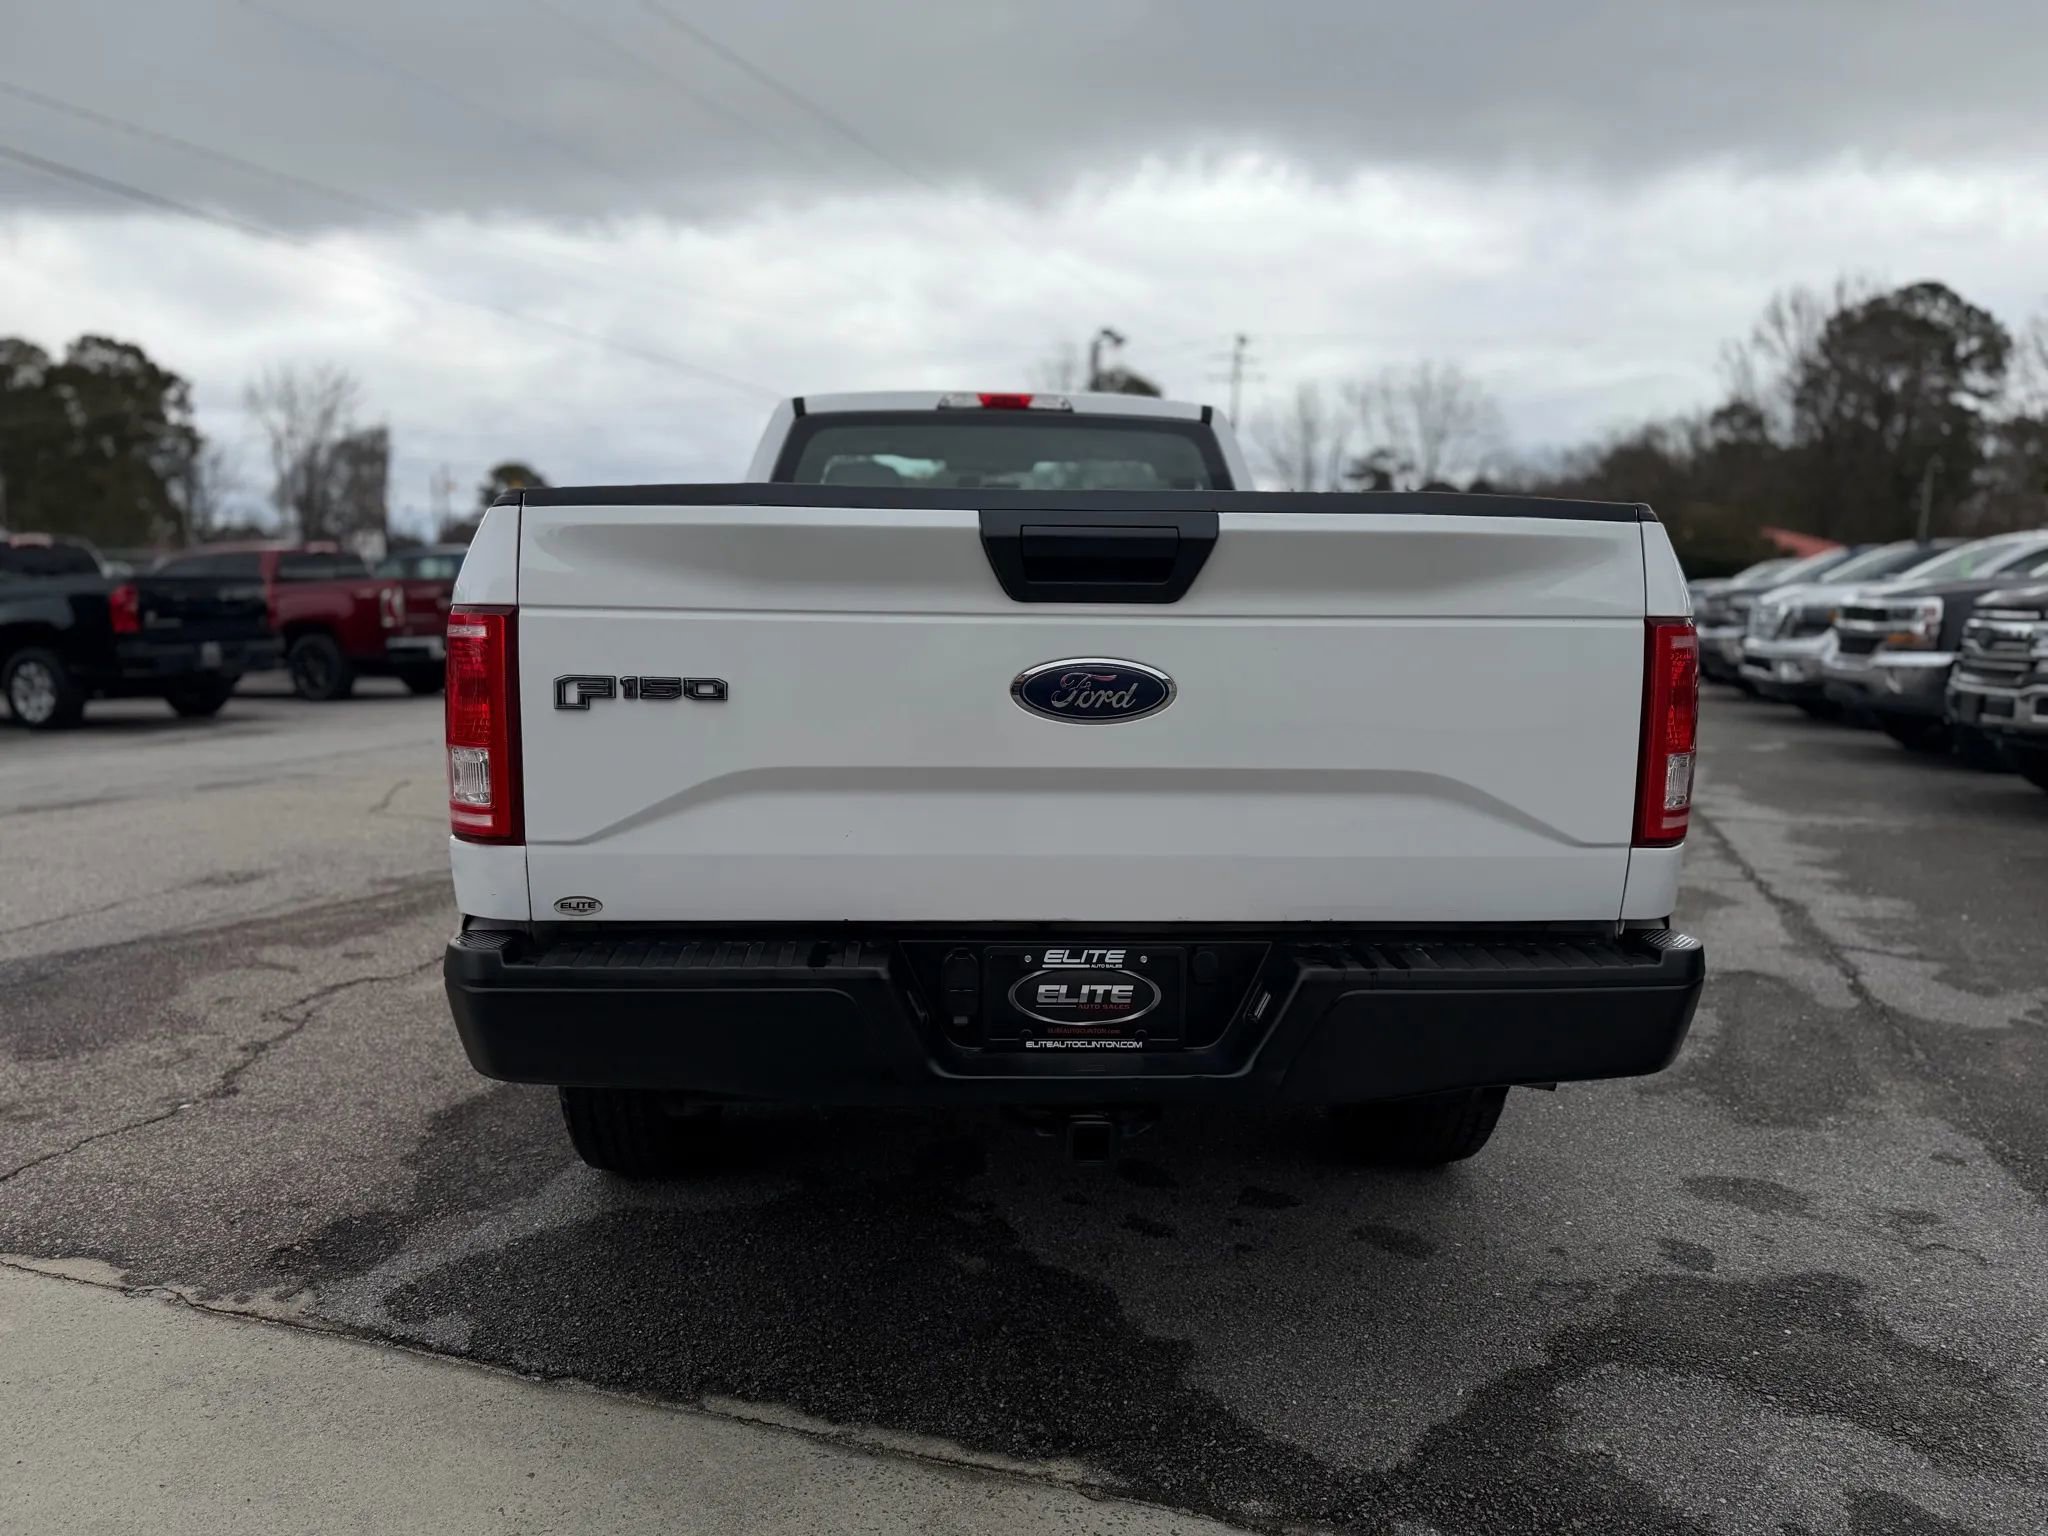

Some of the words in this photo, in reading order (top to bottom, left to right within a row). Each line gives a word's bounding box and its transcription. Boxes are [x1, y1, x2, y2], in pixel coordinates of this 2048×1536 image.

[1051, 672, 1139, 709] Ford
[560, 901, 596, 909] ELITE
[1043, 949, 1127, 963] ELITE
[1036, 984, 1134, 1003] ELITE
[1025, 1041, 1143, 1049] ELITEAUTOCLINTON.COM
